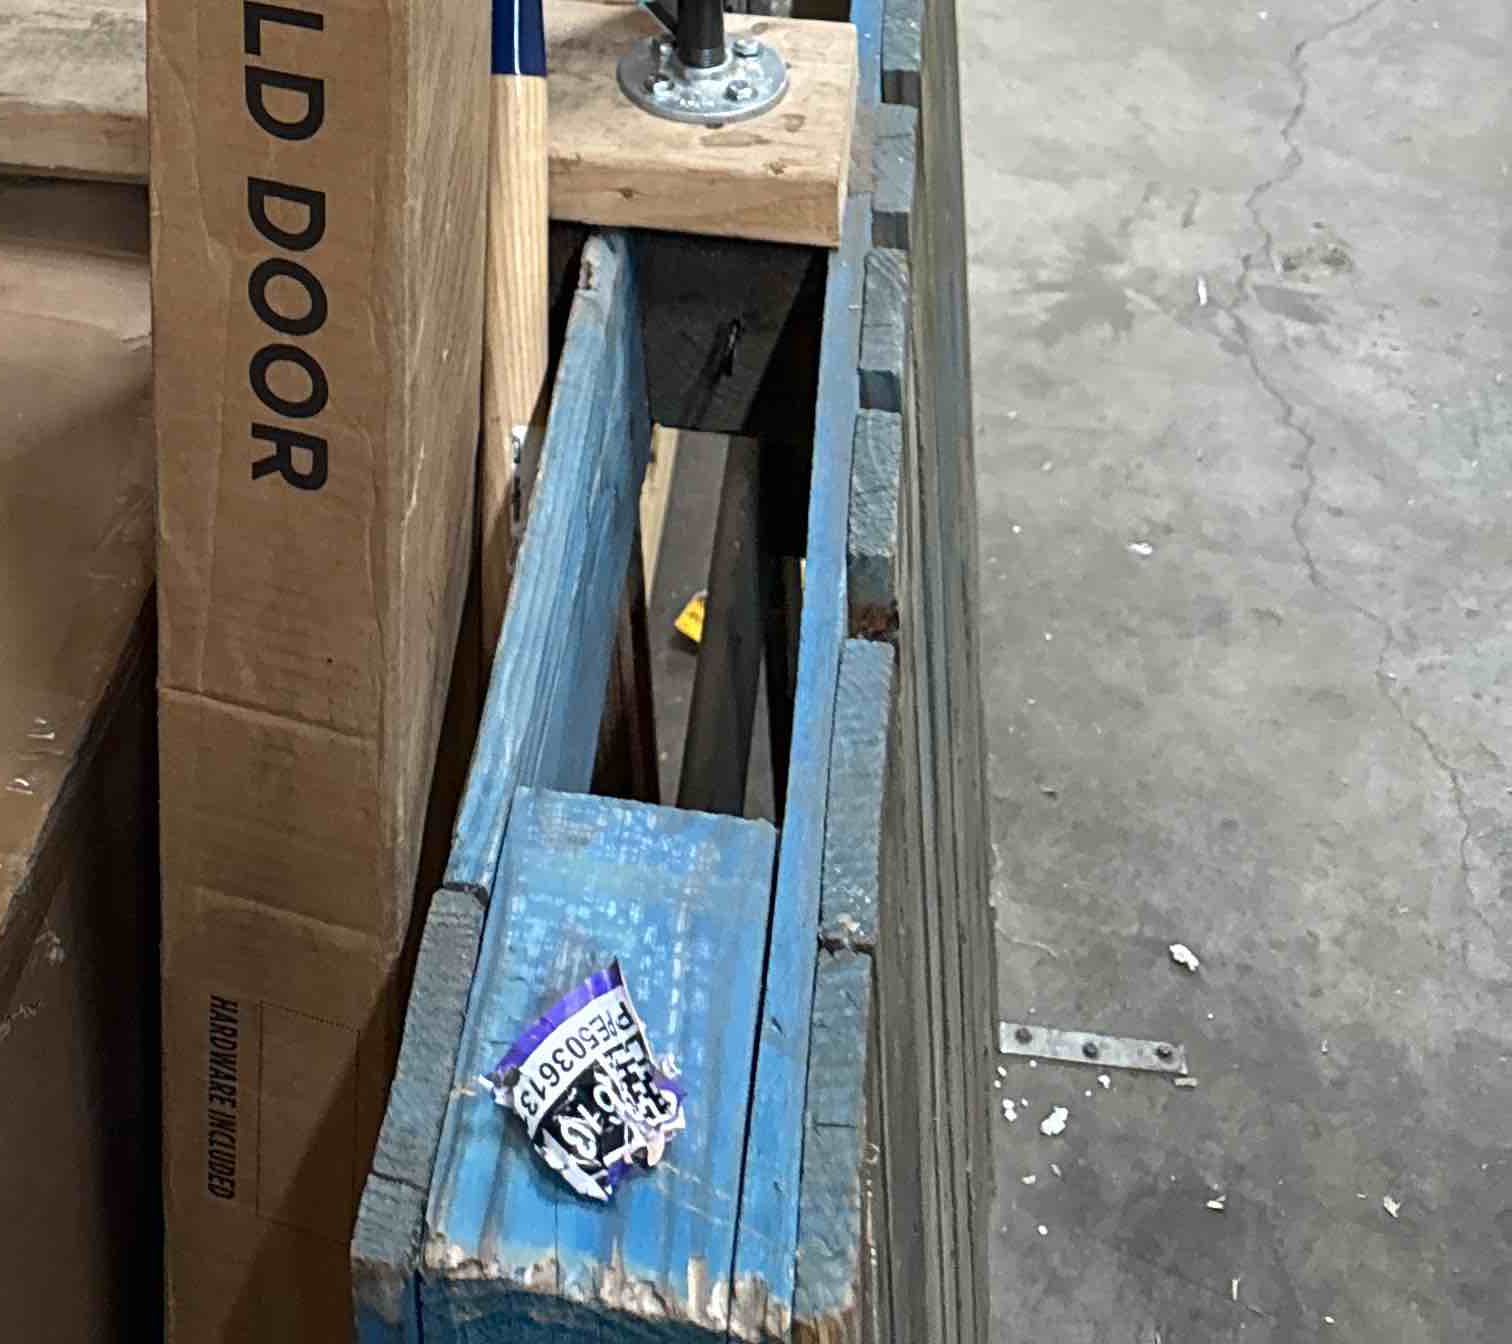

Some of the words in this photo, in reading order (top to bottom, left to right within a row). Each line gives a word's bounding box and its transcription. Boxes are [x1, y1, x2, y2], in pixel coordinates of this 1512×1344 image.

[247, 174, 330, 493] DOOR
[209, 993, 239, 1109] HARDWARE
[518, 1000, 635, 1117] PPE503613
[207, 1108, 237, 1201] INCLUDED
